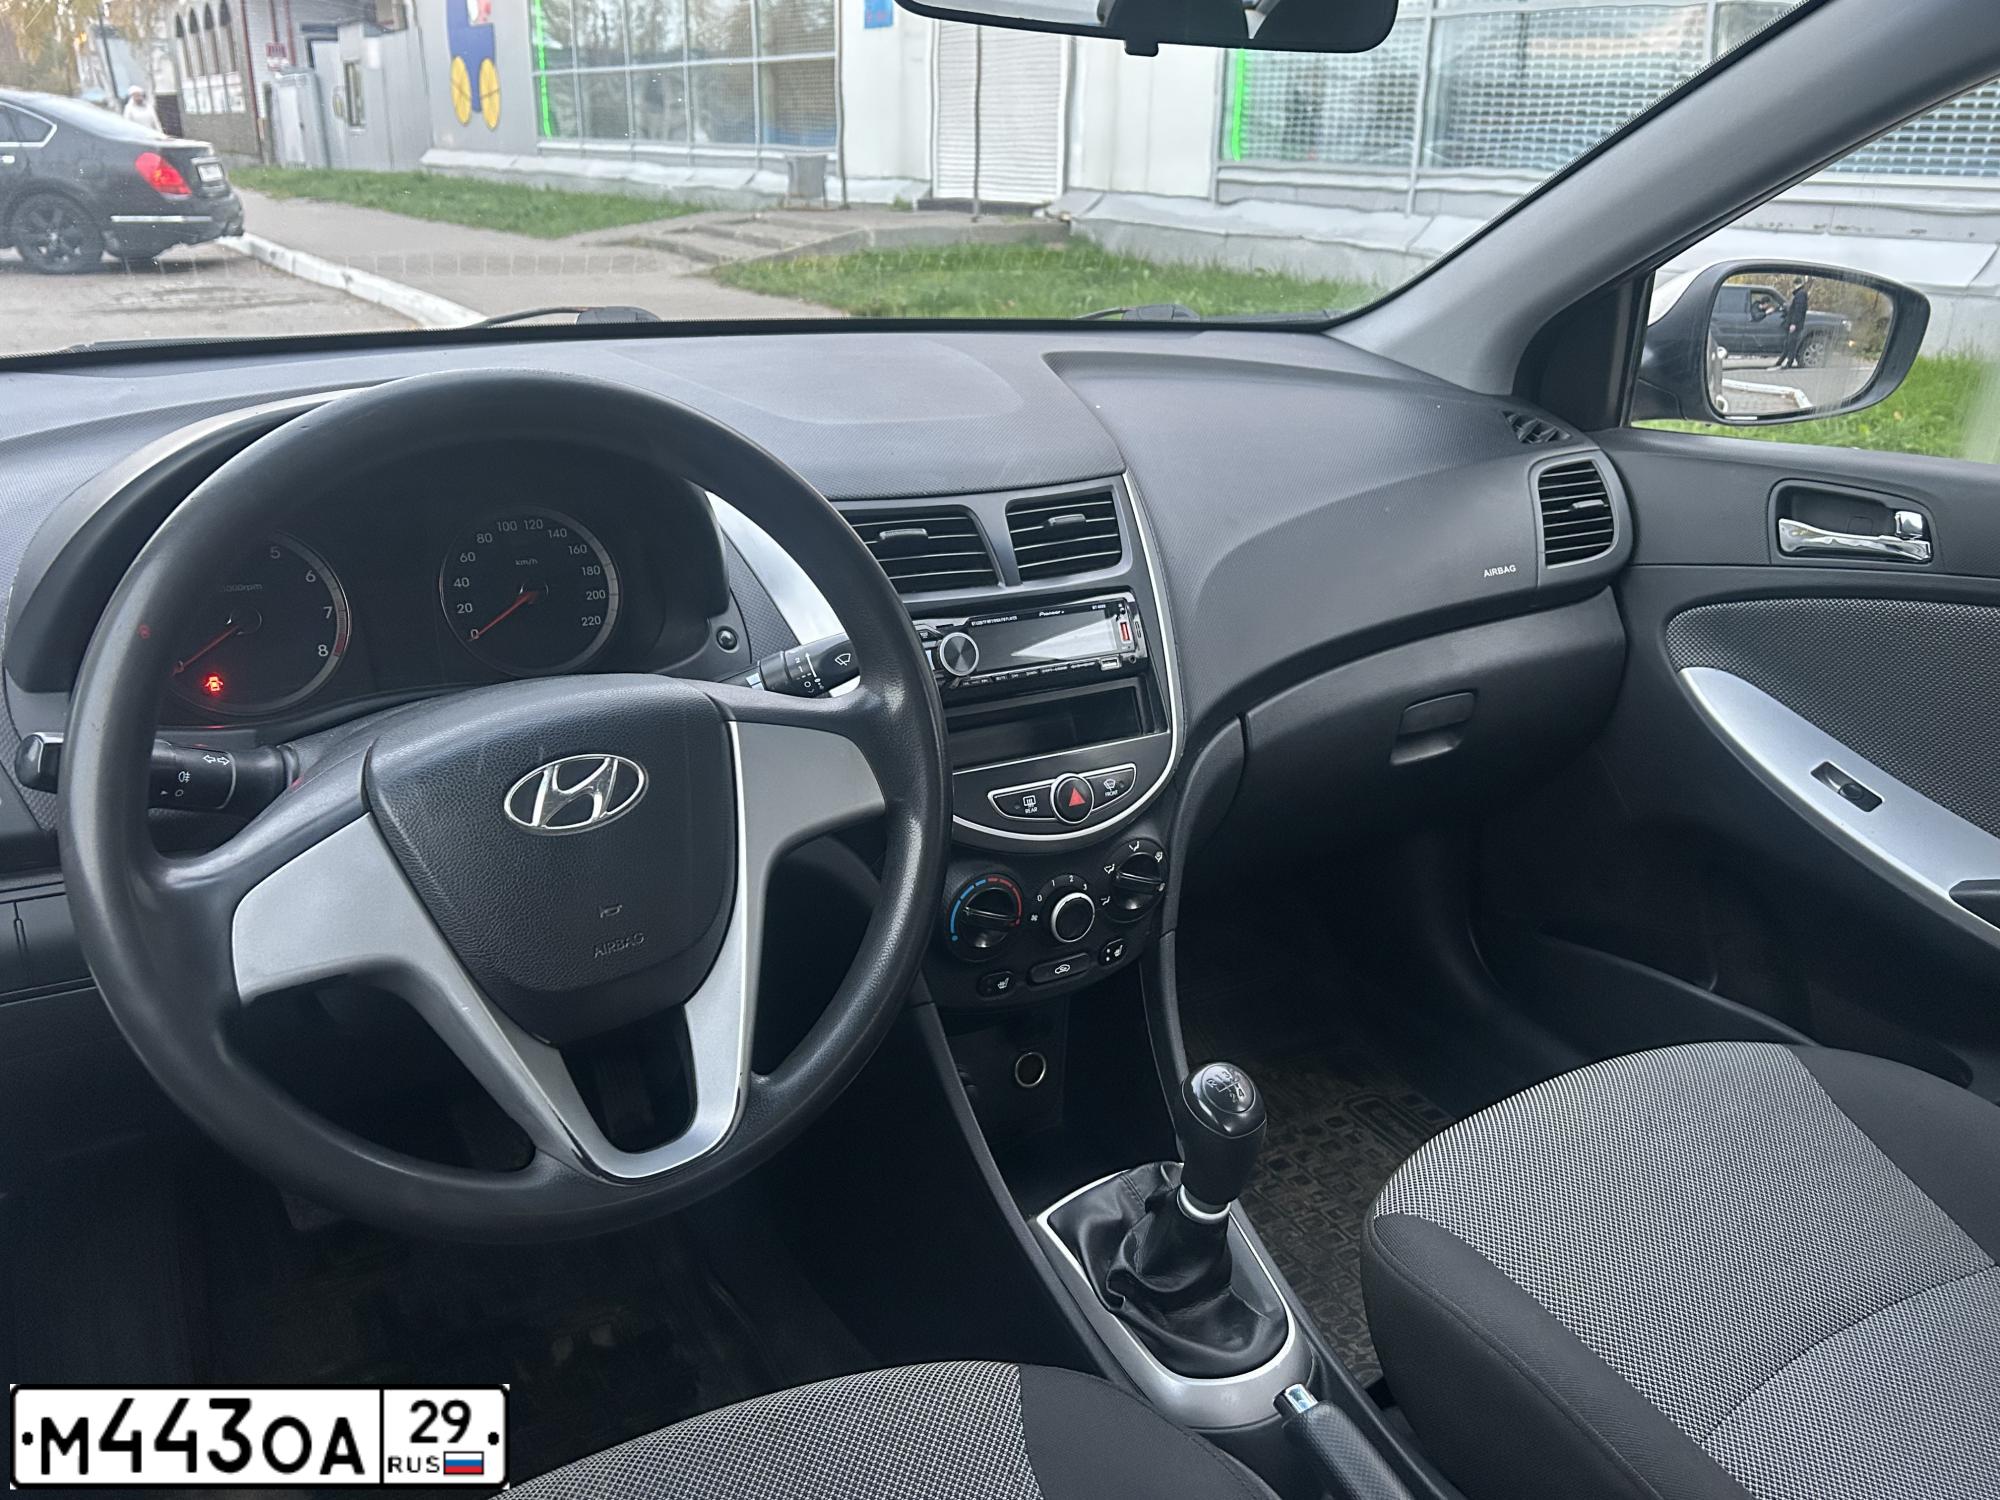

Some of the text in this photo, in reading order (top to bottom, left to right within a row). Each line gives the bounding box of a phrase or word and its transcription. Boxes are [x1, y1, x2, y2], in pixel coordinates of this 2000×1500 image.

[497, 520, 517, 532] 100
[523, 519, 543, 530] 120
[476, 532, 493, 543] 80
[548, 528, 567, 539] 140
[270, 546, 281, 559] 5
[568, 544, 587, 555] 160
[460, 551, 476, 563] 60
[305, 570, 317, 583] 6
[582, 565, 601, 576] 180
[1483, 564, 1516, 578] AIRBAG
[453, 577, 470, 588] 40
[586, 589, 606, 601] 200
[323, 606, 333, 619] 7
[456, 602, 473, 614] 20
[581, 615, 601, 627] 220
[318, 644, 329, 657] 8
[1069, 874, 1074, 883] 2
